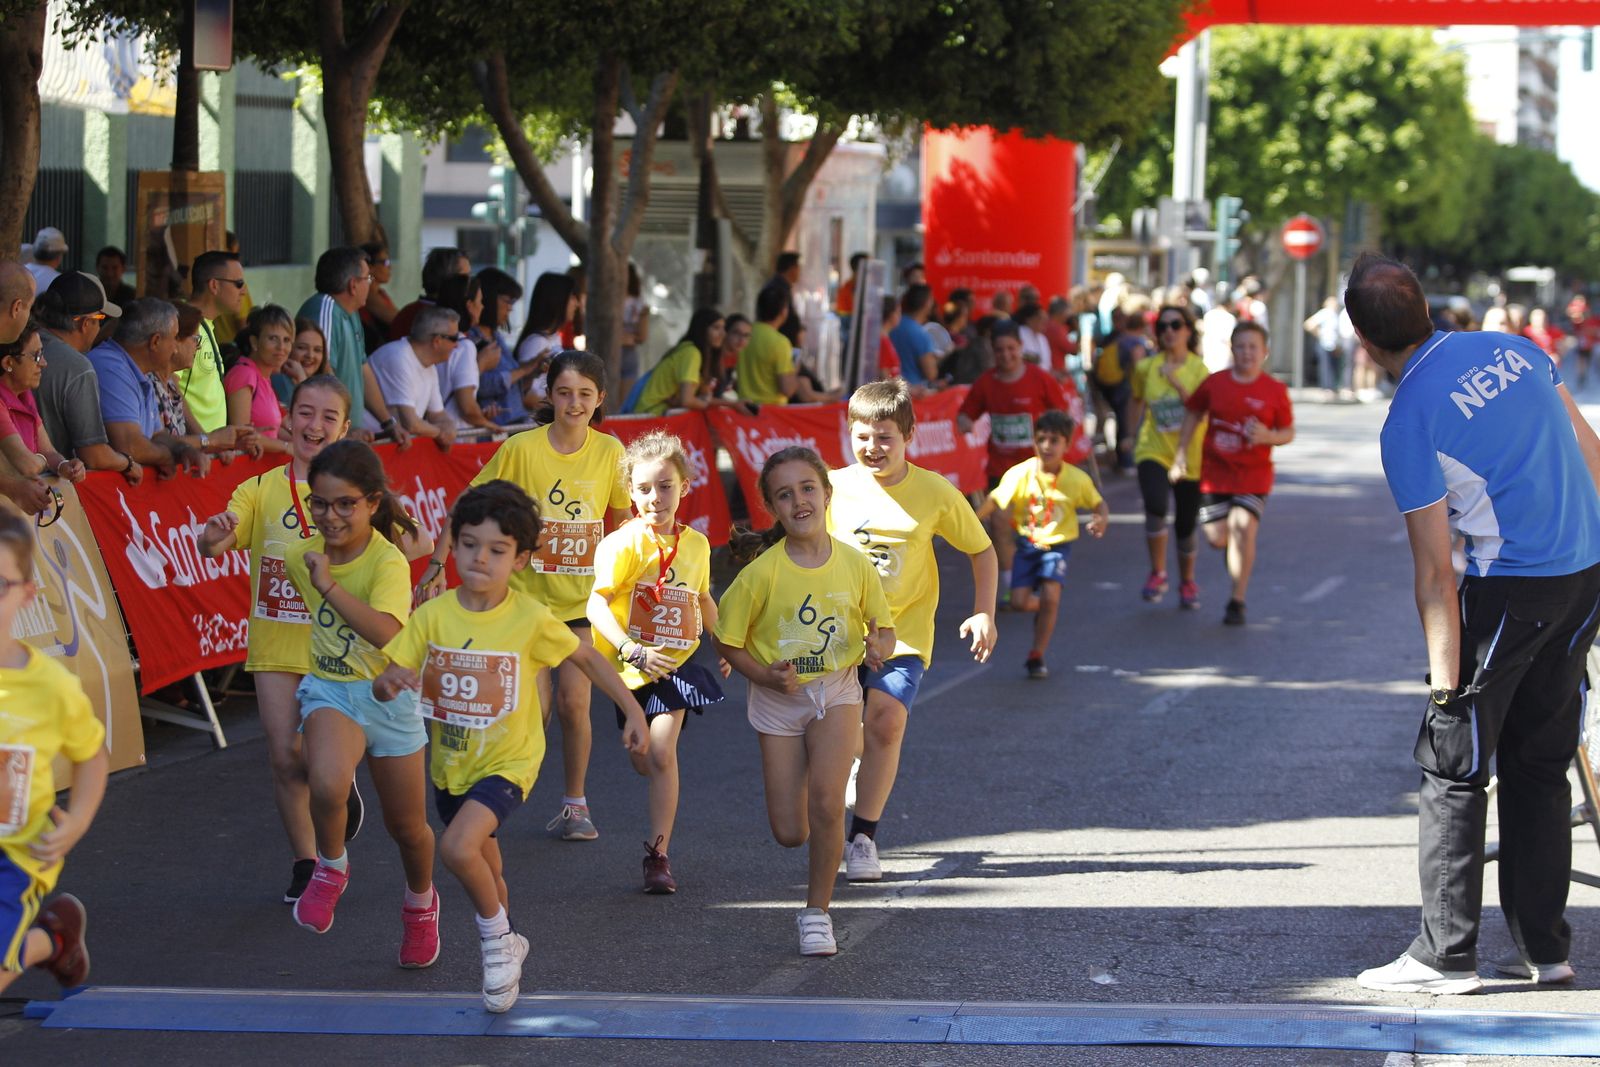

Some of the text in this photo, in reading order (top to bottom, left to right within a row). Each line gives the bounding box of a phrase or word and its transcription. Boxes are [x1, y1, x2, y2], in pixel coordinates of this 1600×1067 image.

[953, 248, 1040, 267] Santander
[1457, 366, 1480, 384] GRUPO
[548, 478, 565, 505] 6
[550, 522, 558, 533] 6
[548, 537, 588, 556] 120
[271, 560, 278, 573] 6
[561, 556, 579, 565] CELIA
[268, 577, 302, 599] 26
[279, 599, 306, 611] CLAUDIA
[798, 593, 817, 626] 6
[651, 604, 682, 627] 23
[655, 625, 683, 637] MARTINA
[435, 651, 446, 667] 6
[450, 654, 488, 664] CARRERA
[440, 672, 479, 700] 99
[438, 696, 468, 712] RODRIGO
[469, 702, 493, 714] MACK
